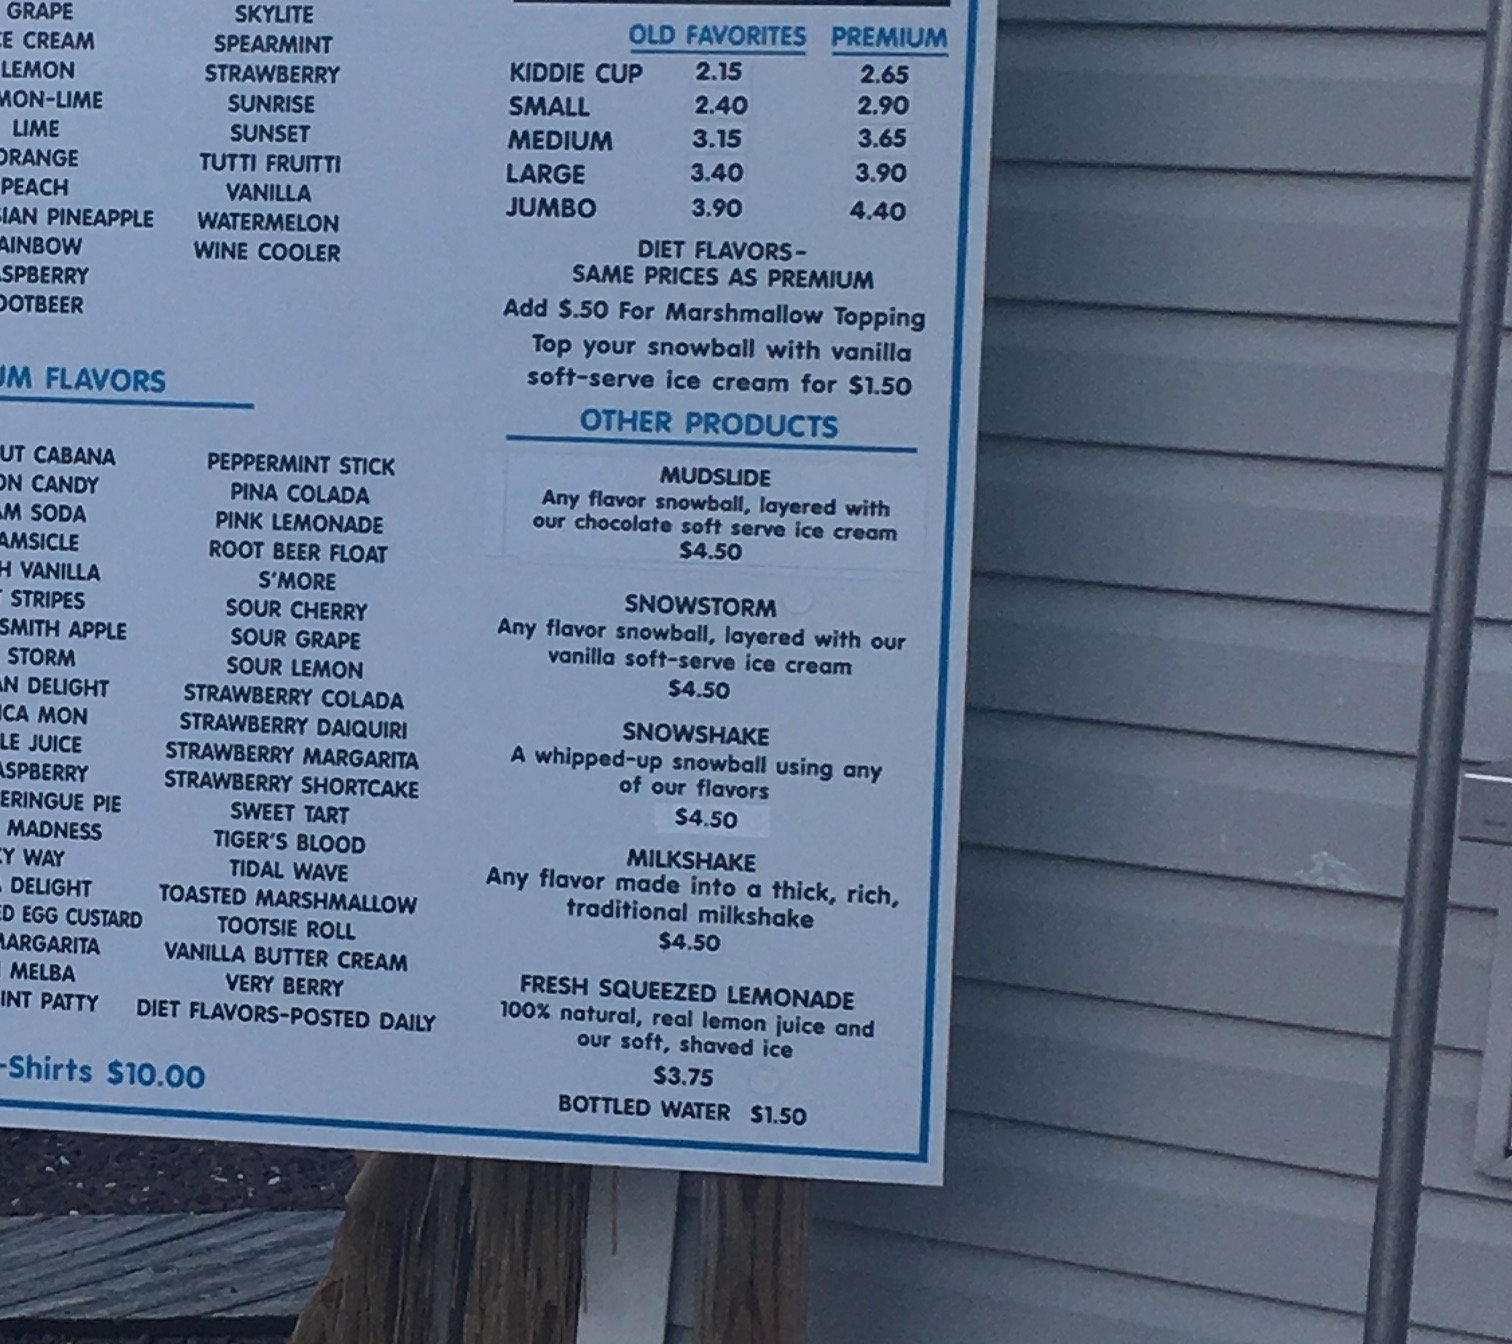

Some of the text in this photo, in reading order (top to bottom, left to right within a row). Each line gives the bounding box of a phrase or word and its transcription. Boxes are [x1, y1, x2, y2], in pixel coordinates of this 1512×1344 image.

[6, 1, 74, 21] GRAPE
[234, 4, 314, 25] SKYLITE
[22, 30, 95, 51] CREAM
[213, 33, 334, 55] SPEARMINT
[628, 23, 808, 48] OLD FAVORITES
[831, 25, 948, 49] PREMIUM
[204, 63, 341, 85] STRAWBERRY
[509, 61, 644, 84] KIDDIE CUP
[695, 61, 743, 82] 2.15
[860, 63, 910, 85] 2.65
[508, 95, 591, 118] SMALL
[694, 94, 749, 116] 2.40
[857, 94, 910, 116] 2.90
[507, 128, 614, 152] MEDIUM
[692, 128, 742, 149] 3.15
[857, 127, 907, 149] 3.65
[199, 152, 342, 174] TUTTI FRUITTI
[506, 162, 586, 185] LARGE
[690, 162, 744, 183] 3.40
[855, 162, 908, 183] 3.90
[47, 207, 155, 229] PINEAPPLE
[505, 196, 597, 219] JUMBO
[691, 197, 743, 219] 3.90
[849, 200, 907, 222] 4.40
[197, 211, 340, 233] WATERMELON
[193, 240, 341, 263] WINE COOLER
[502, 297, 926, 333] Add $.50 For Marshmallow Topping
[45, 366, 166, 394] FLAVORS
[527, 365, 913, 397] soft-serve ice cream for $1.50
[580, 408, 840, 440] OTHER PRODUCTS
[33, 444, 117, 466] CABANA
[207, 451, 396, 477] PEPPERMINT STICK
[659, 465, 772, 488] MUDSLIDE
[679, 540, 743, 561] $4.50
[258, 570, 337, 592] S'MORE
[624, 593, 778, 618] SNOWSTORM
[68, 620, 127, 641] APPLE
[179, 711, 408, 740] STRAWBERRY DAIQUIRI
[622, 721, 770, 747] SNOWSHAKE
[213, 829, 366, 855] TIGER'S BLOOD
[626, 848, 757, 873] MILKSHAKE
[225, 972, 345, 998] VERY BERRY
[520, 973, 855, 1011] FRESH SQUEEZED LEMONADE
[40, 991, 99, 1013] PATTY
[106, 1058, 206, 1090] $10.00
[558, 1093, 808, 1127] BOTTLED WATER $1.50
